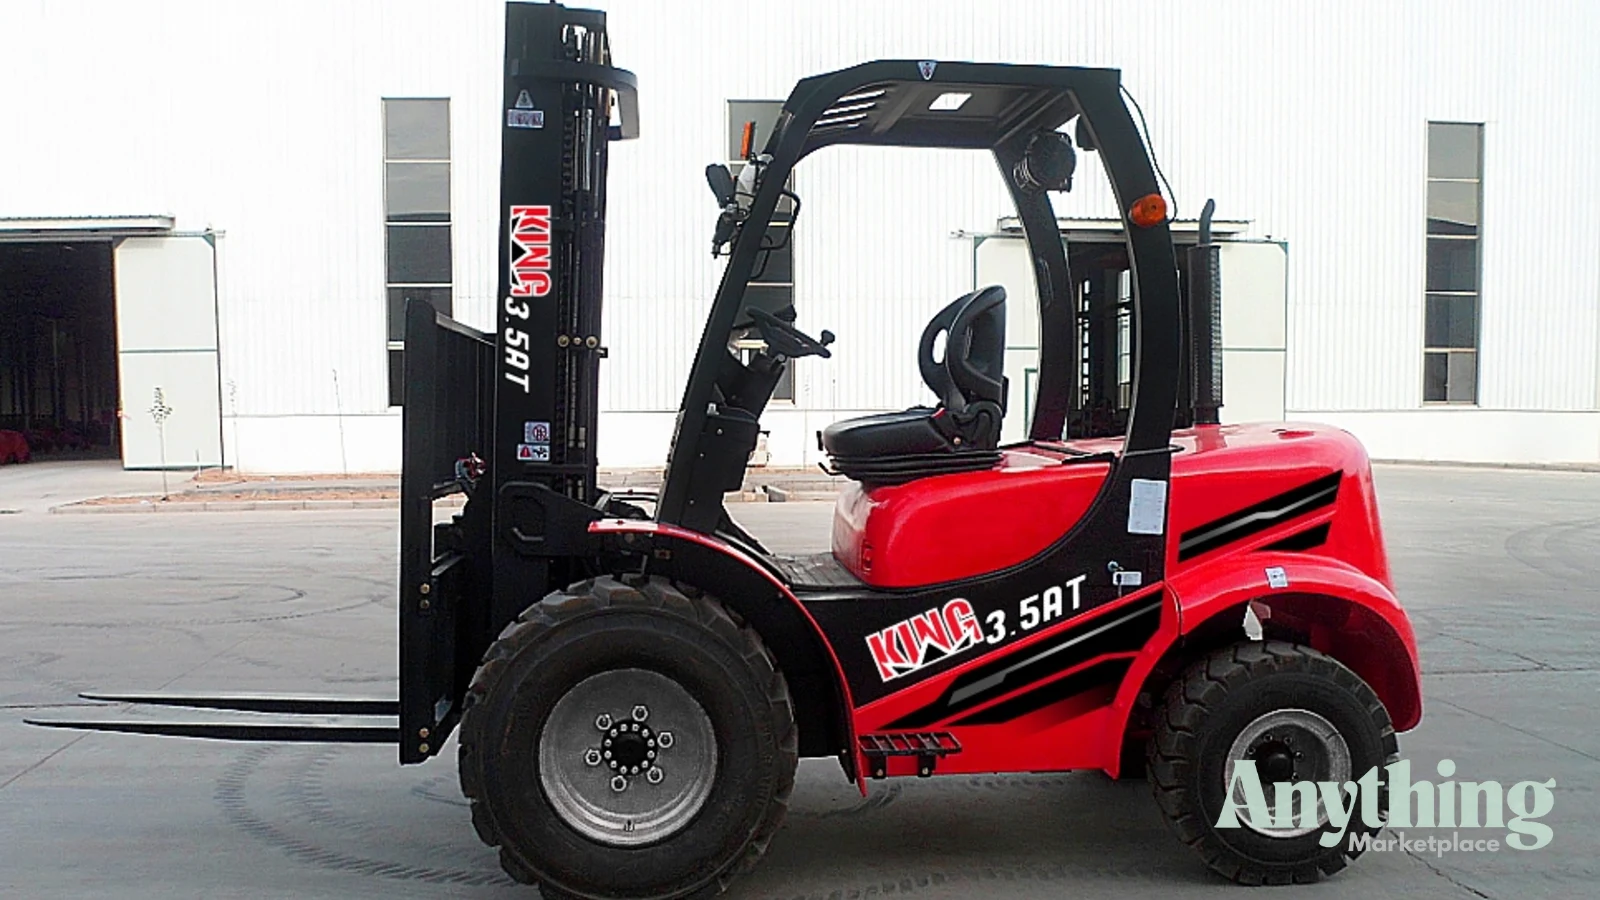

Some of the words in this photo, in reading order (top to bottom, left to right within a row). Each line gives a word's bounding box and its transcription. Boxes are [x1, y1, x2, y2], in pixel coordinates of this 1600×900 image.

[510, 205, 552, 297] KING
[504, 297, 530, 393] 3.5AT
[865, 597, 984, 682] KING
[986, 575, 1087, 645] 3.5AT
